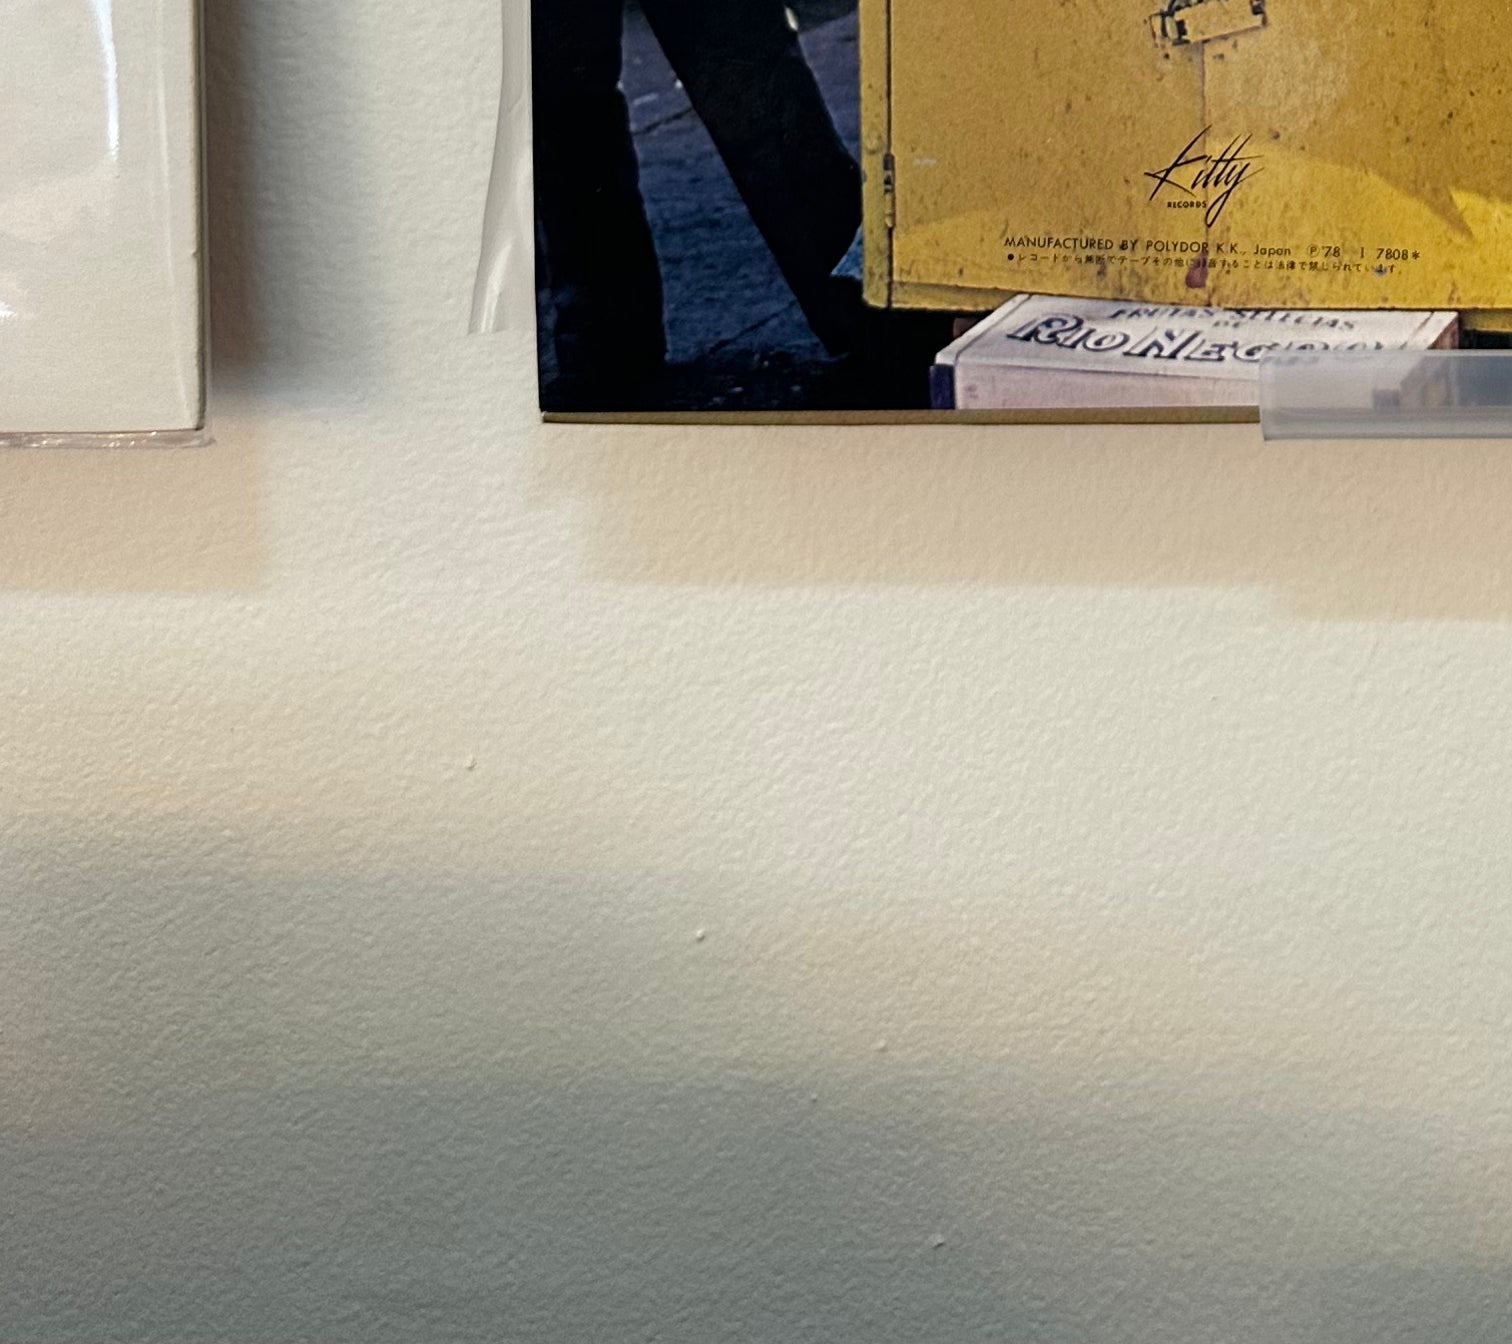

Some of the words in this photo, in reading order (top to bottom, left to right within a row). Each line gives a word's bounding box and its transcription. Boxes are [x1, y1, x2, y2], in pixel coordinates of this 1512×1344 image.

[1143, 124, 1265, 228] Kitty
[1167, 200, 1207, 209] RECORDS
[1004, 236, 1114, 251] MANUFACTURED
[1119, 238, 1139, 252] BY
[1146, 239, 1209, 254] POLYDOR
[1253, 244, 1292, 258] Japan
